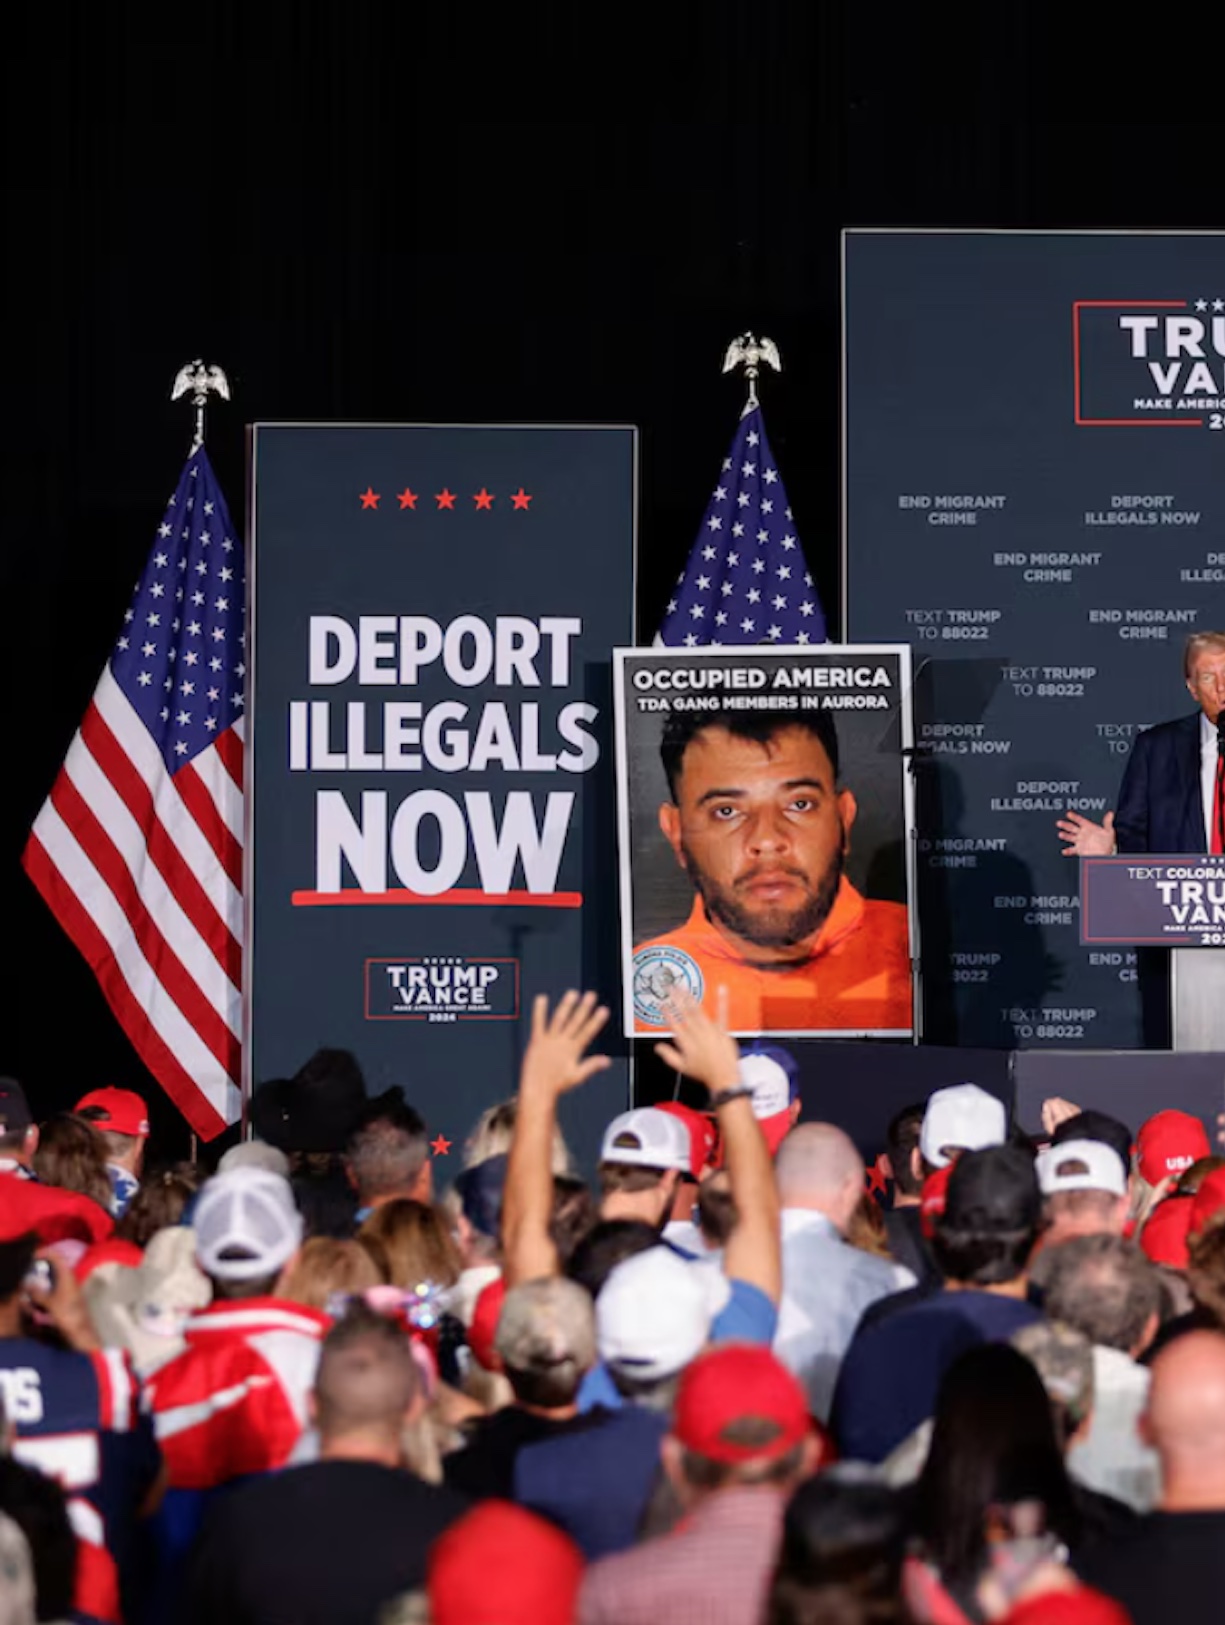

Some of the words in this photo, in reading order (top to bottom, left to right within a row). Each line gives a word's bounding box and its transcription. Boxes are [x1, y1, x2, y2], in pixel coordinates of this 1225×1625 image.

[1134, 399, 1172, 409] MAKE
[899, 496, 931, 508] END
[935, 496, 1006, 508] MIGRANT
[1112, 496, 1174, 507] DEPORT
[928, 512, 976, 524] CRIME
[1086, 512, 1158, 524] ILLEGALS
[1161, 512, 1200, 524] NOW
[994, 553, 1027, 565] END
[1030, 553, 1101, 565] MIGRANT
[1024, 569, 1071, 582] CRIME
[905, 610, 943, 623] TEXT
[947, 611, 1001, 622] TRUMP
[1090, 610, 1122, 622] END
[1126, 610, 1197, 622] MIGRANT
[917, 626, 938, 639] TO
[942, 627, 988, 639] 88022
[1119, 627, 1167, 639] CRIME
[310, 616, 580, 686] DEPORT
[634, 669, 766, 690] OCCUPIED
[773, 668, 891, 687] AMERICA
[1002, 667, 1039, 680] TEXT
[1043, 667, 1096, 679] TRUMP
[1013, 684, 1033, 696] TO
[1037, 684, 1084, 696] 88022
[638, 698, 670, 710] TDA
[673, 697, 720, 710] GANG
[723, 696, 798, 709] MEMBERS
[801, 696, 818, 708] IN
[822, 696, 888, 708] AURORA
[922, 724, 984, 736] DEPORT
[1096, 724, 1133, 737] TEXT
[289, 701, 599, 772] ILLEGALS
[972, 741, 1010, 753] NOW
[1108, 741, 1129, 753] TO
[1017, 782, 1079, 793] DEPORT
[991, 798, 1063, 810] ILLEGALS
[1067, 798, 1106, 810] NOW
[316, 789, 575, 895] NOW
[935, 839, 1006, 851] MIGRANT
[1128, 868, 1163, 879] TEXT
[994, 896, 1027, 908] END
[1031, 896, 1080, 908] MIGRA
[1024, 913, 1072, 924] CRIME
[1090, 953, 1122, 965] END
[387, 966, 498, 987] TRUMP
[400, 988, 485, 1004] VANCE
[1043, 1009, 1096, 1021] TRUMP
[1013, 1026, 1033, 1037] TO
[1037, 1025, 1083, 1038] 88022
